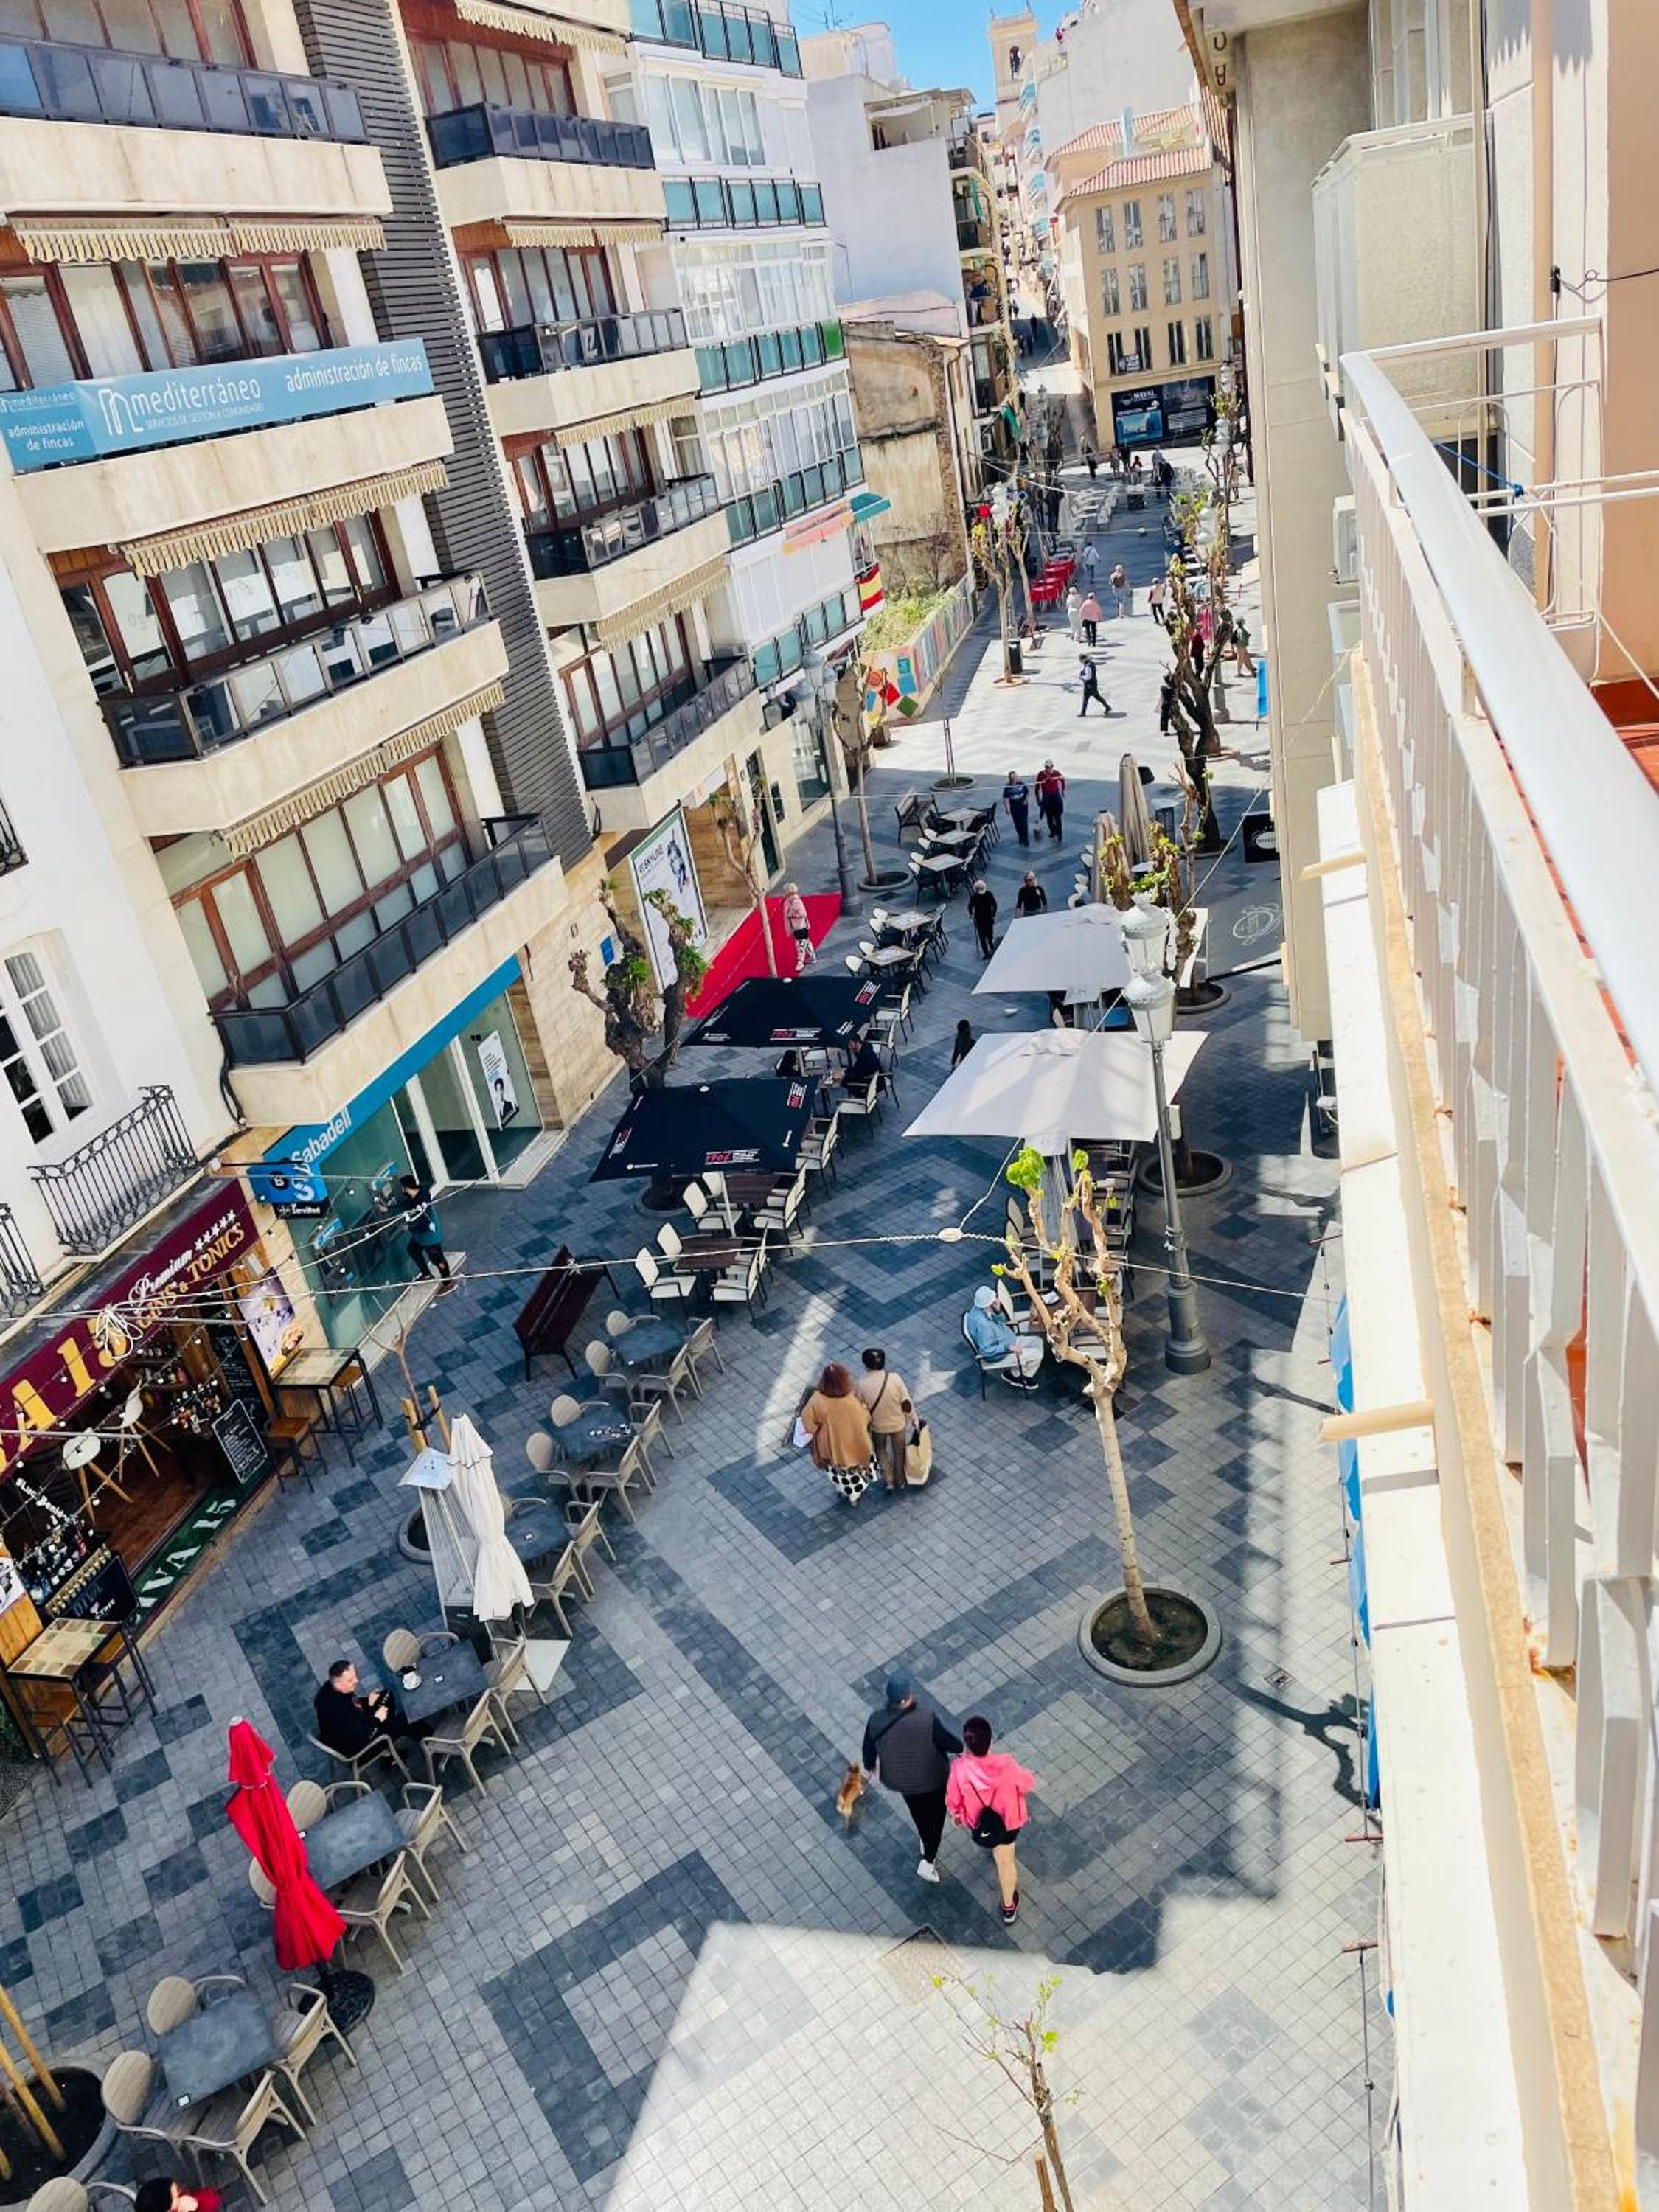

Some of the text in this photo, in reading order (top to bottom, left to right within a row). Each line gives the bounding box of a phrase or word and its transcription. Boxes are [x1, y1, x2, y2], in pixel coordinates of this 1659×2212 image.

[285, 354, 422, 392] administración de fincas
[131, 378, 260, 416] mediterráneo
[7, 420, 84, 437] administración
[27, 437, 74, 451] de fincas
[291, 1106, 352, 1175] Sabadell
[187, 1222, 245, 1282] TONICS
